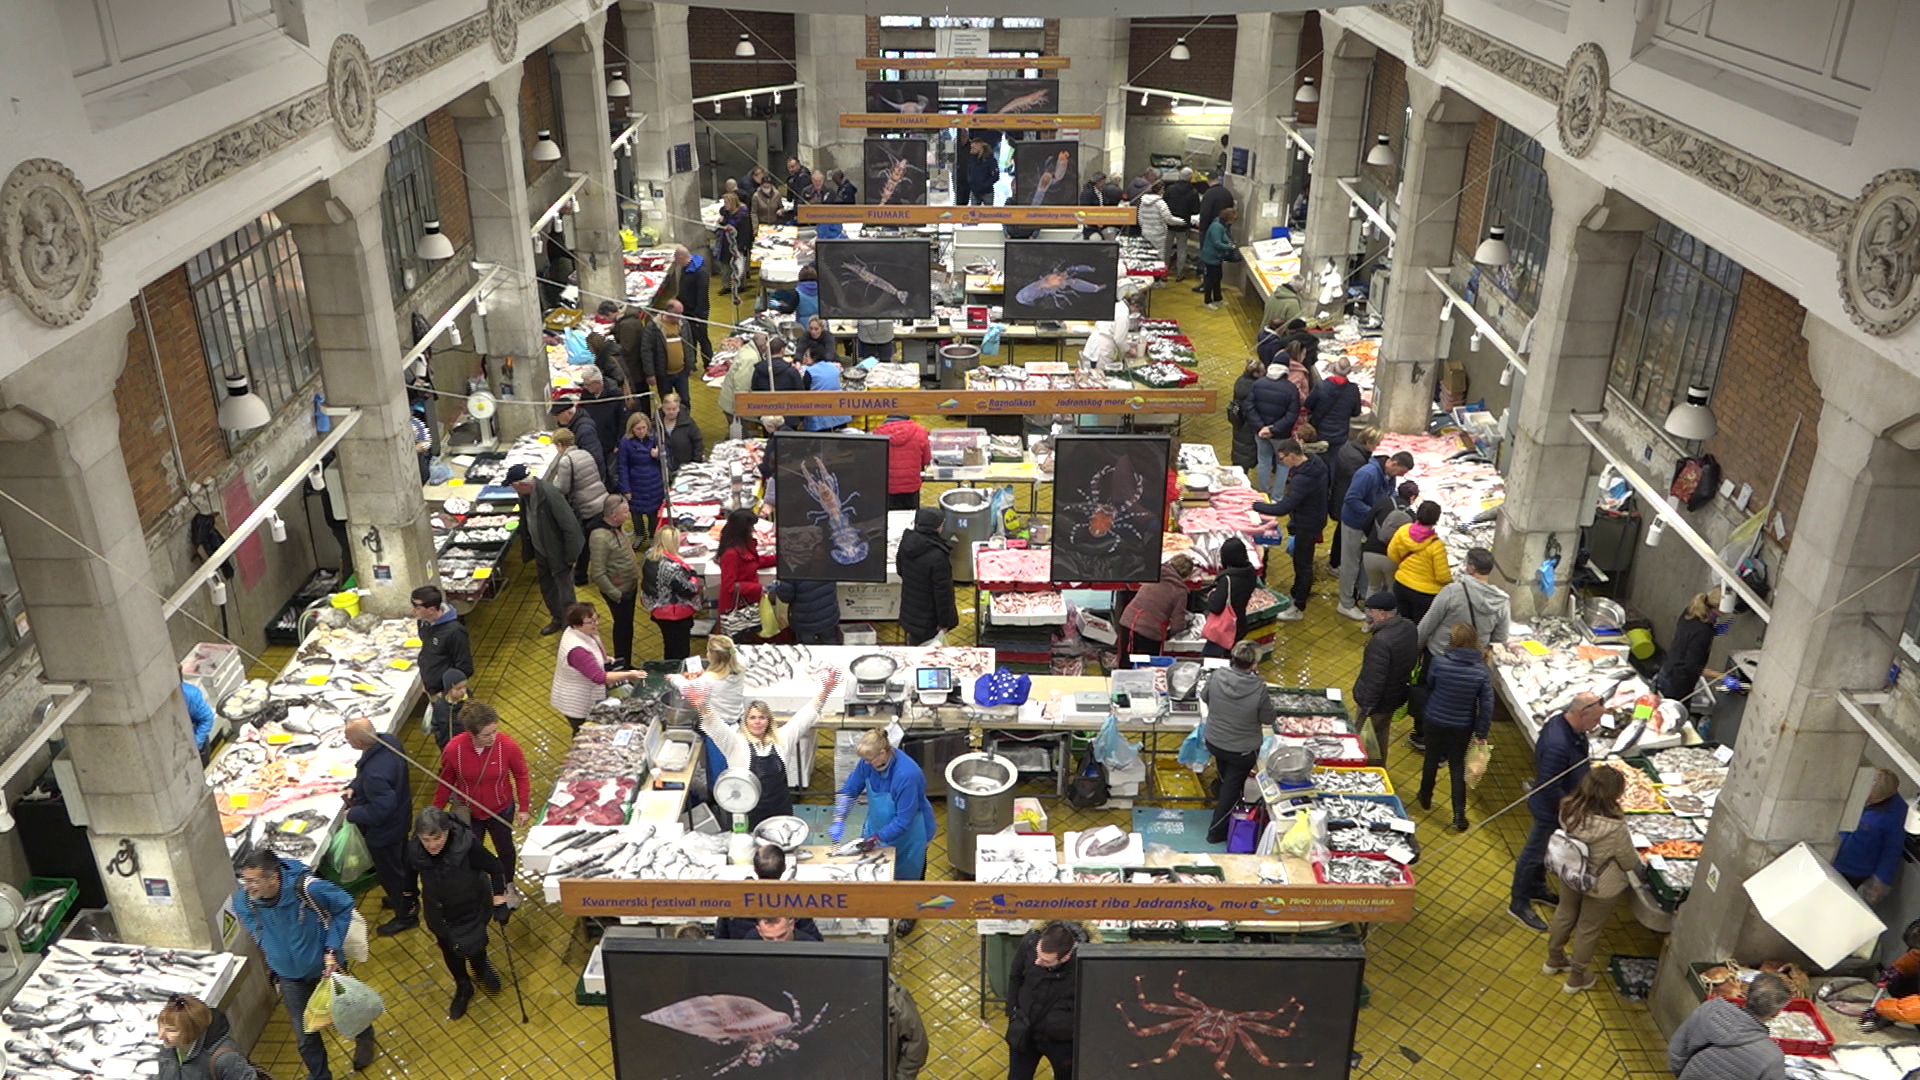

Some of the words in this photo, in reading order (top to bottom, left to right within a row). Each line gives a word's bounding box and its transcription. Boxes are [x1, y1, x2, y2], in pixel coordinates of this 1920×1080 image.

[868, 210, 910, 219] FIUMARE
[839, 398, 898, 409] FIUMARE
[989, 398, 1036, 408] Raznolikost
[1056, 398, 1102, 408] Jadranskog
[958, 519, 968, 528] 14
[955, 796, 966, 810] 13
[582, 896, 648, 908] Kvarnerski
[650, 896, 696, 910] festival
[699, 899, 731, 908] mora
[743, 892, 848, 909] FIUMARE
[1102, 896, 1129, 909] riba
